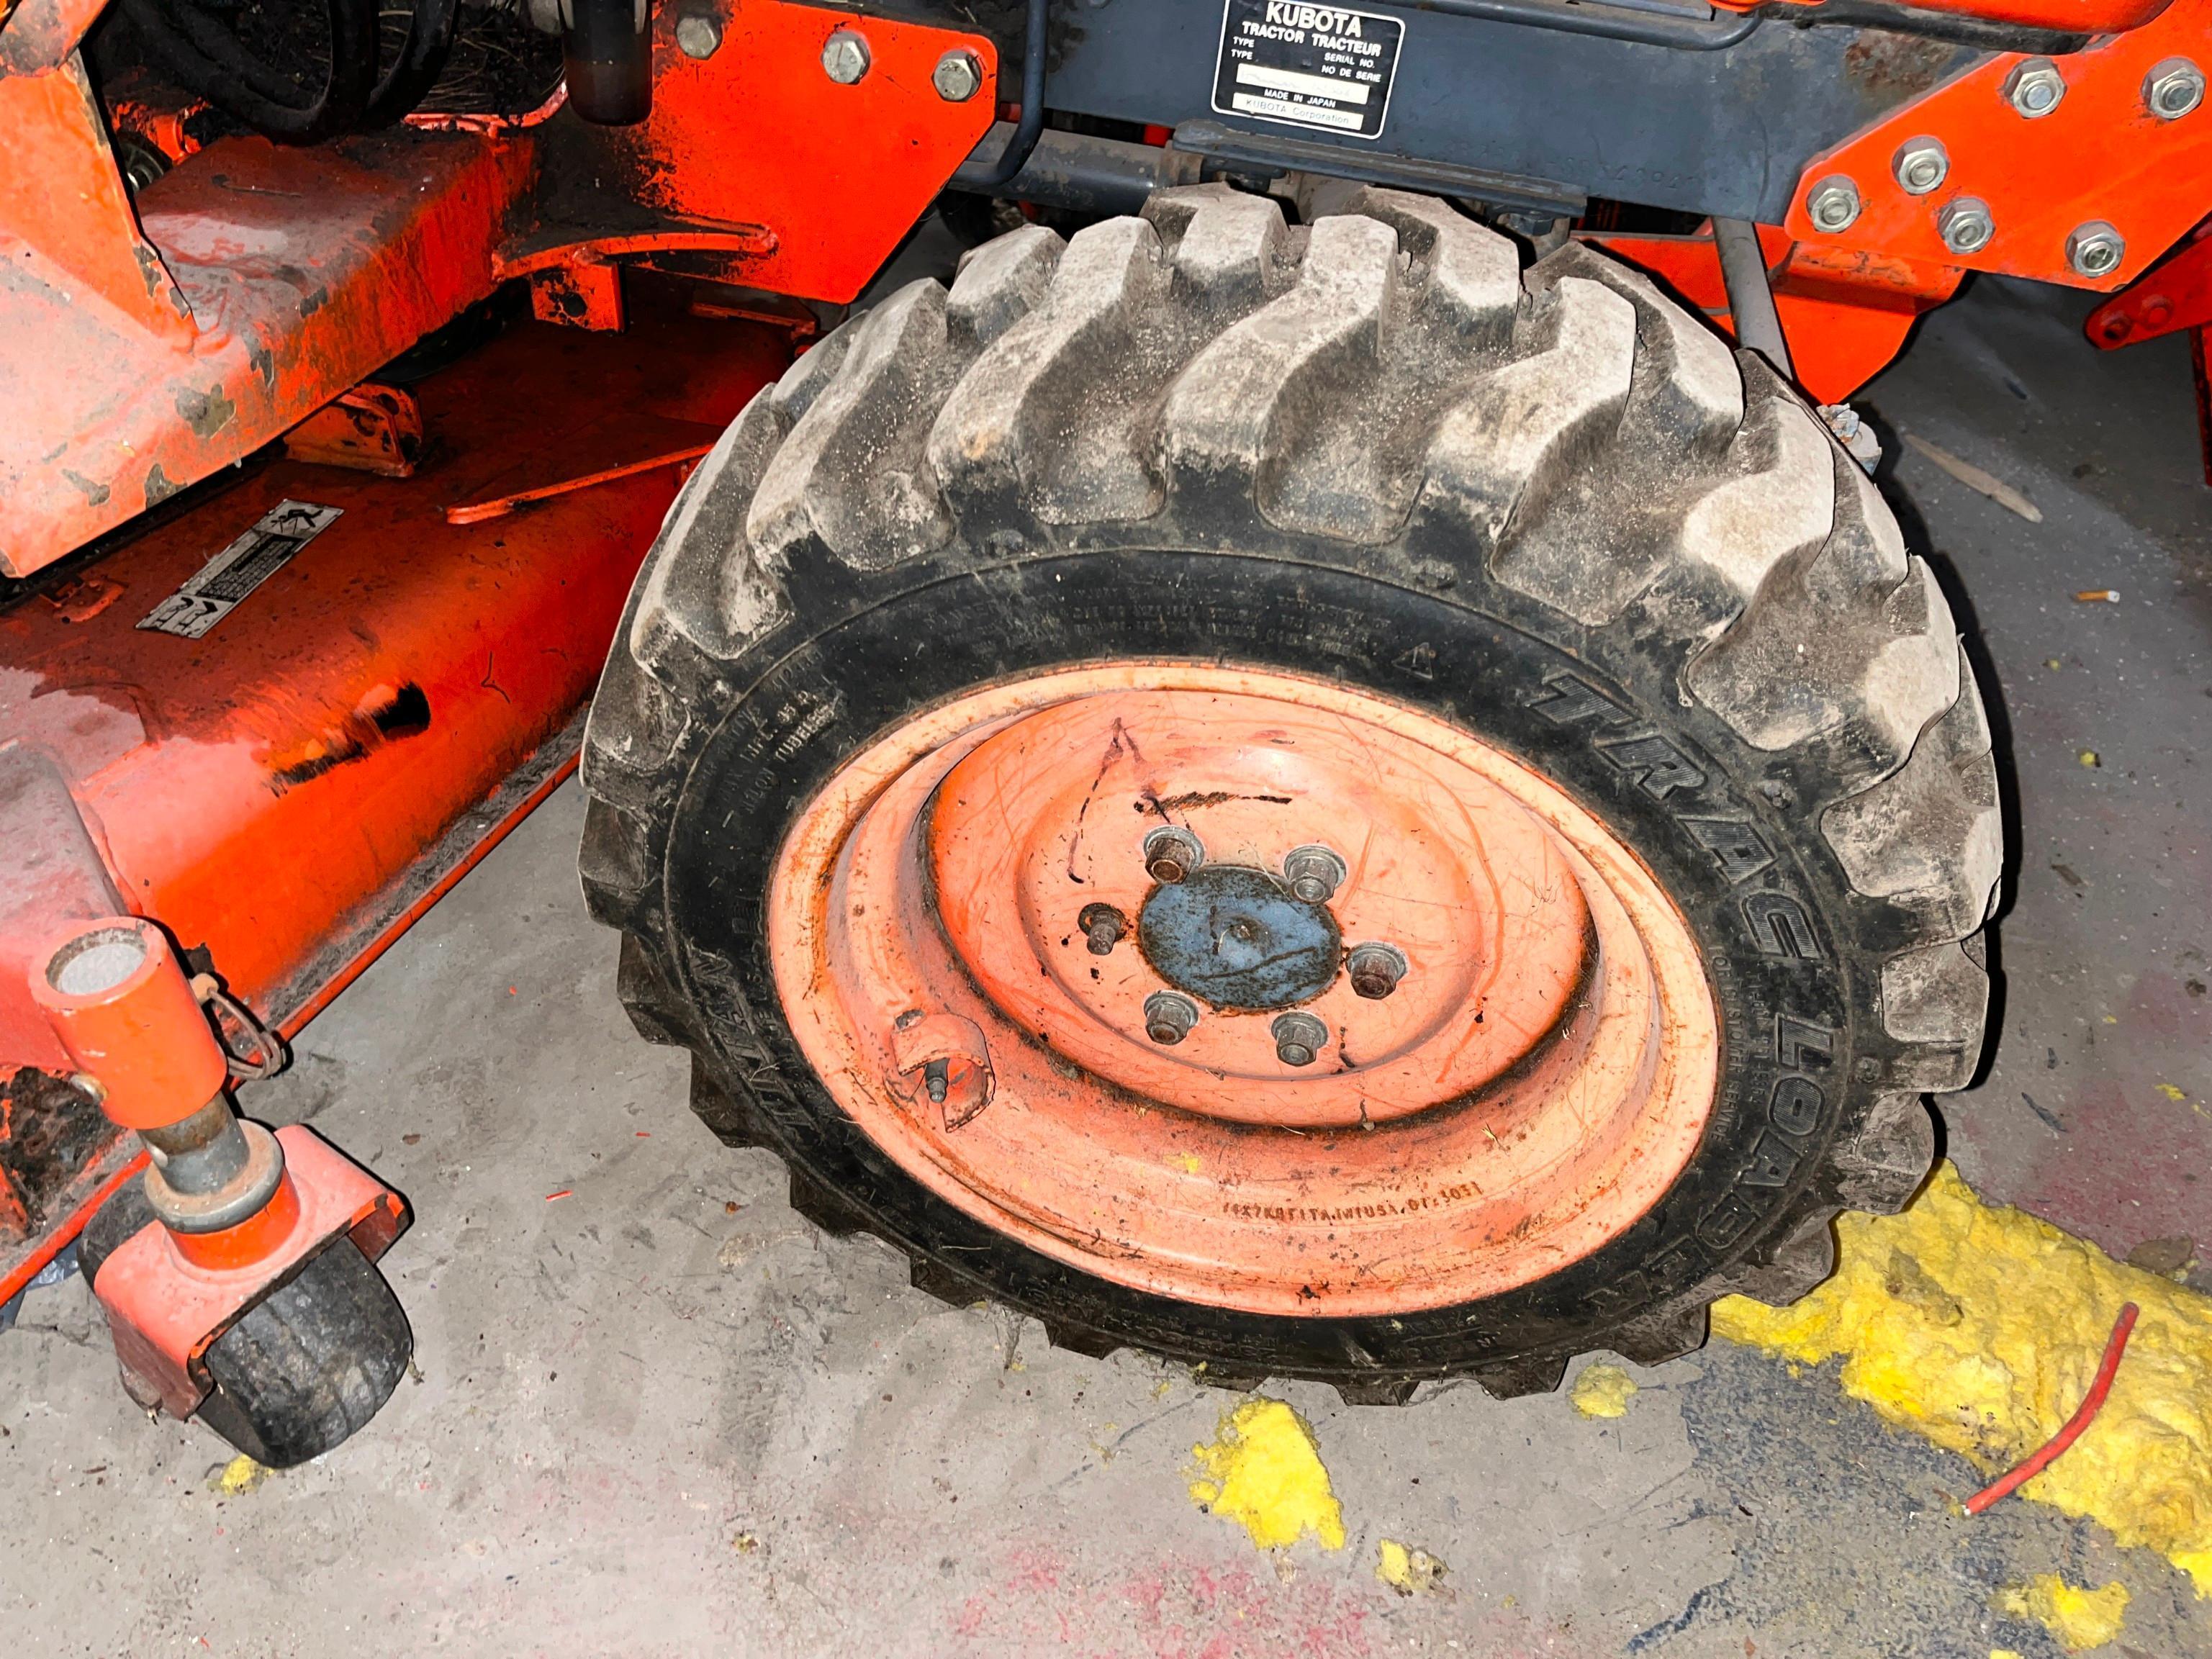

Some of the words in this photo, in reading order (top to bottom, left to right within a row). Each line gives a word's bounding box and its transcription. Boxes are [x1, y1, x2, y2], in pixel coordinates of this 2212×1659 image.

[1265, 2, 1361, 37] KUBOTA
[1233, 36, 1255, 48] TYPE
[1242, 21, 1304, 44] TRACTOR
[1312, 33, 1381, 57] TRACTEUR
[1231, 49, 1252, 60] TYPE
[1324, 53, 1355, 65] SERIAL
[1359, 58, 1375, 68] NO.
[1321, 65, 1335, 74] NO
[1340, 68, 1352, 78] DE
[1355, 71, 1381, 83] SERIE
[1264, 89, 1288, 101] MADE
[1294, 94, 1303, 103] IN
[1307, 96, 1335, 108] JAPAN
[1246, 99, 1286, 114] KUBOTA
[1292, 109, 1350, 125] Corporation
[1526, 671, 1827, 960] TRAC
[1710, 1080, 1741, 1142] SERVICE
